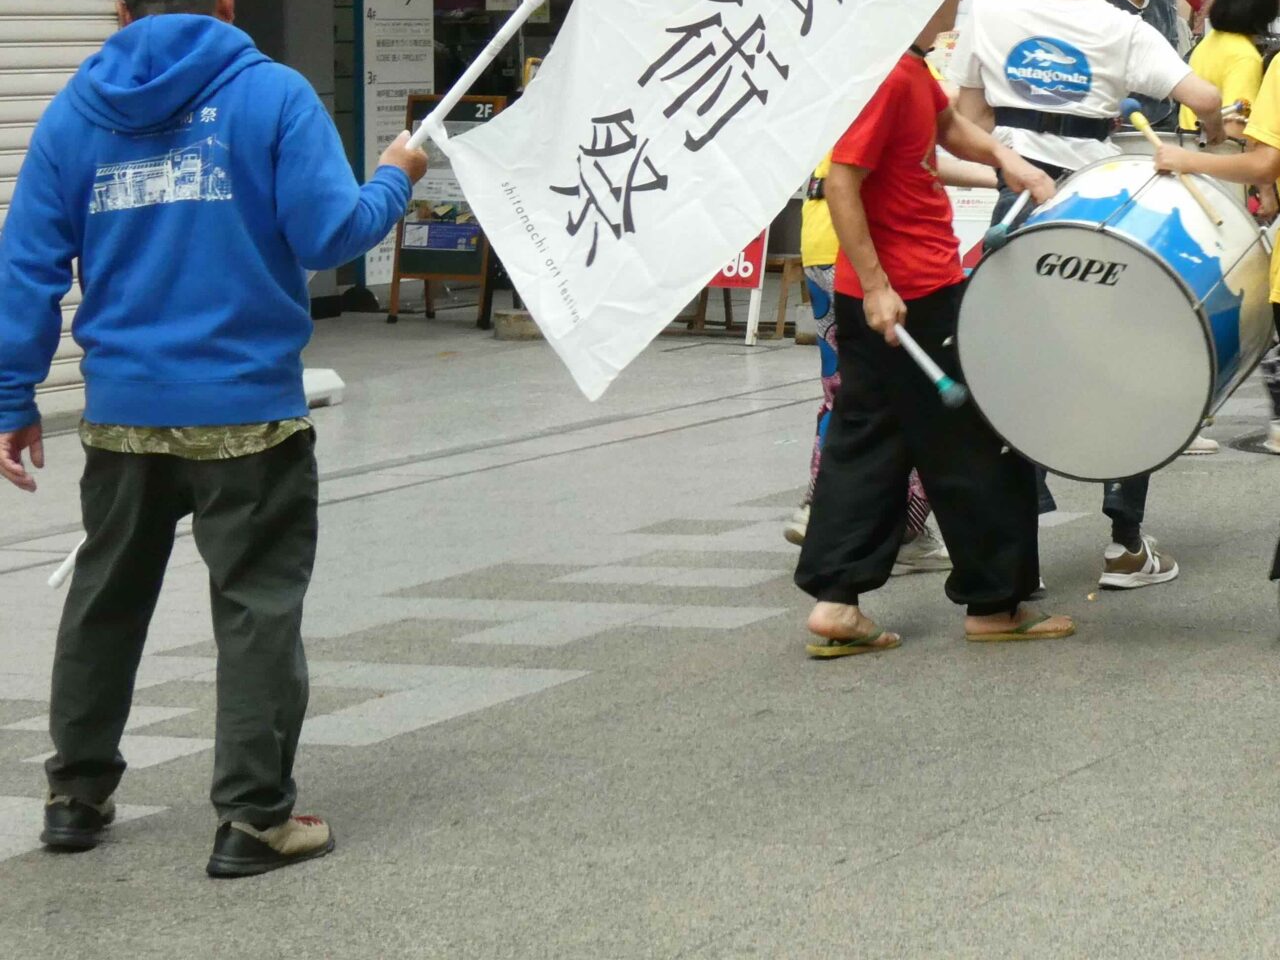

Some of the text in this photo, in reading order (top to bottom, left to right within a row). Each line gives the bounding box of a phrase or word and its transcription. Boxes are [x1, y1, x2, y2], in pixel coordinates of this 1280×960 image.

[475, 103, 494, 118] 2F
[1036, 253, 1128, 287] GOPE
[545, 258, 561, 278] art
[557, 279, 582, 324] festiva
